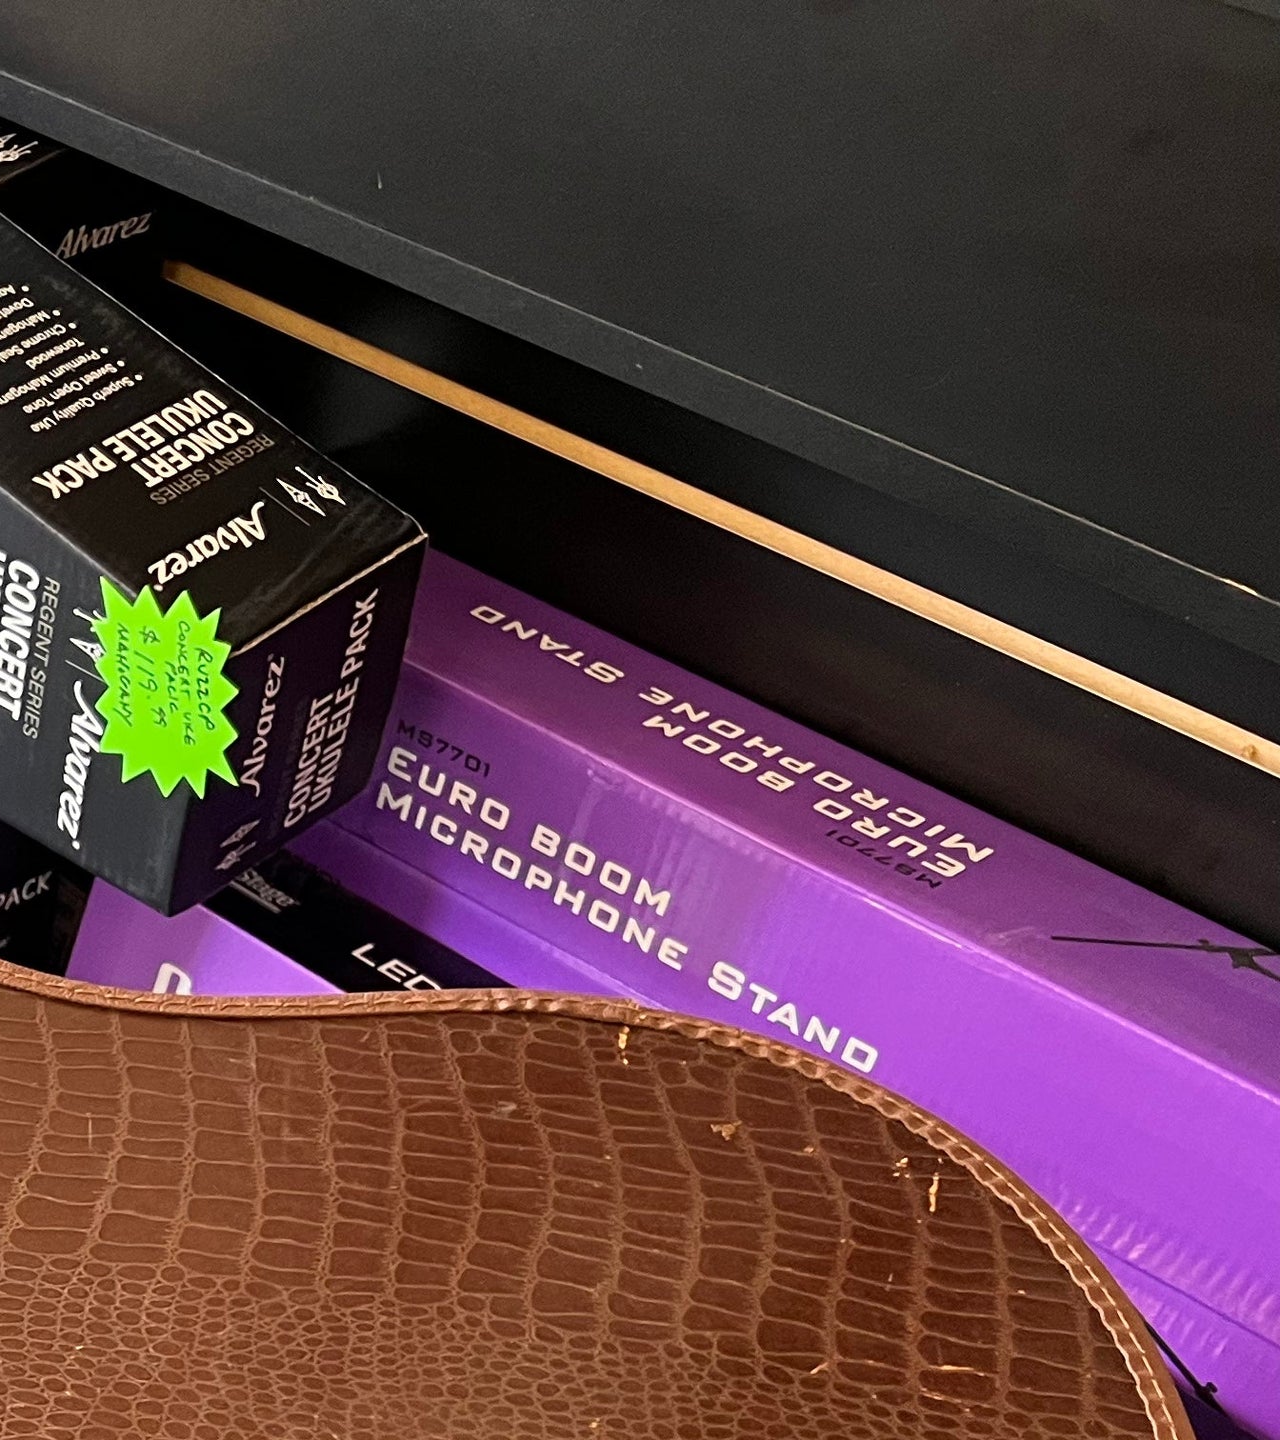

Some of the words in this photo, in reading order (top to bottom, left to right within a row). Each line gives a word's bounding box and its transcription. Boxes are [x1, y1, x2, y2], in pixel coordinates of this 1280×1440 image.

[53, 211, 153, 260] Alvarez
[21, 323, 67, 349] Chrome
[25, 337, 85, 370] Tonewood
[49, 349, 101, 378] Premium
[22, 397, 55, 414] Tone
[49, 381, 83, 401] Open
[52, 397, 96, 422] Quality
[79, 362, 118, 386] Sweet
[92, 376, 135, 401] Superb
[101, 389, 228, 461] UKULELE
[131, 411, 255, 489] CONCERT
[212, 433, 276, 476] REGENT
[32, 447, 117, 500] PACK
[149, 470, 211, 505] SERIES
[147, 501, 265, 586] Alvarez
[34, 576, 61, 668] REGENT
[469, 605, 625, 684] STAND
[22, 666, 48, 740] SERIES
[240, 655, 285, 798] Alvarez
[307, 676, 360, 814] UKULELE
[340, 588, 380, 680] PACK
[57, 680, 104, 841] Alvarez
[283, 691, 335, 828] CONCERT
[396, 719, 491, 778] MS7701
[637, 686, 994, 863] MICROPHONE
[642, 715, 796, 793] BOOM
[387, 746, 511, 831] EURO
[530, 823, 671, 917] BOOM
[812, 798, 967, 879] EURO
[825, 829, 942, 890] MS7701
[375, 782, 689, 972] MICROPHONE
[707, 961, 880, 1074] STAND
